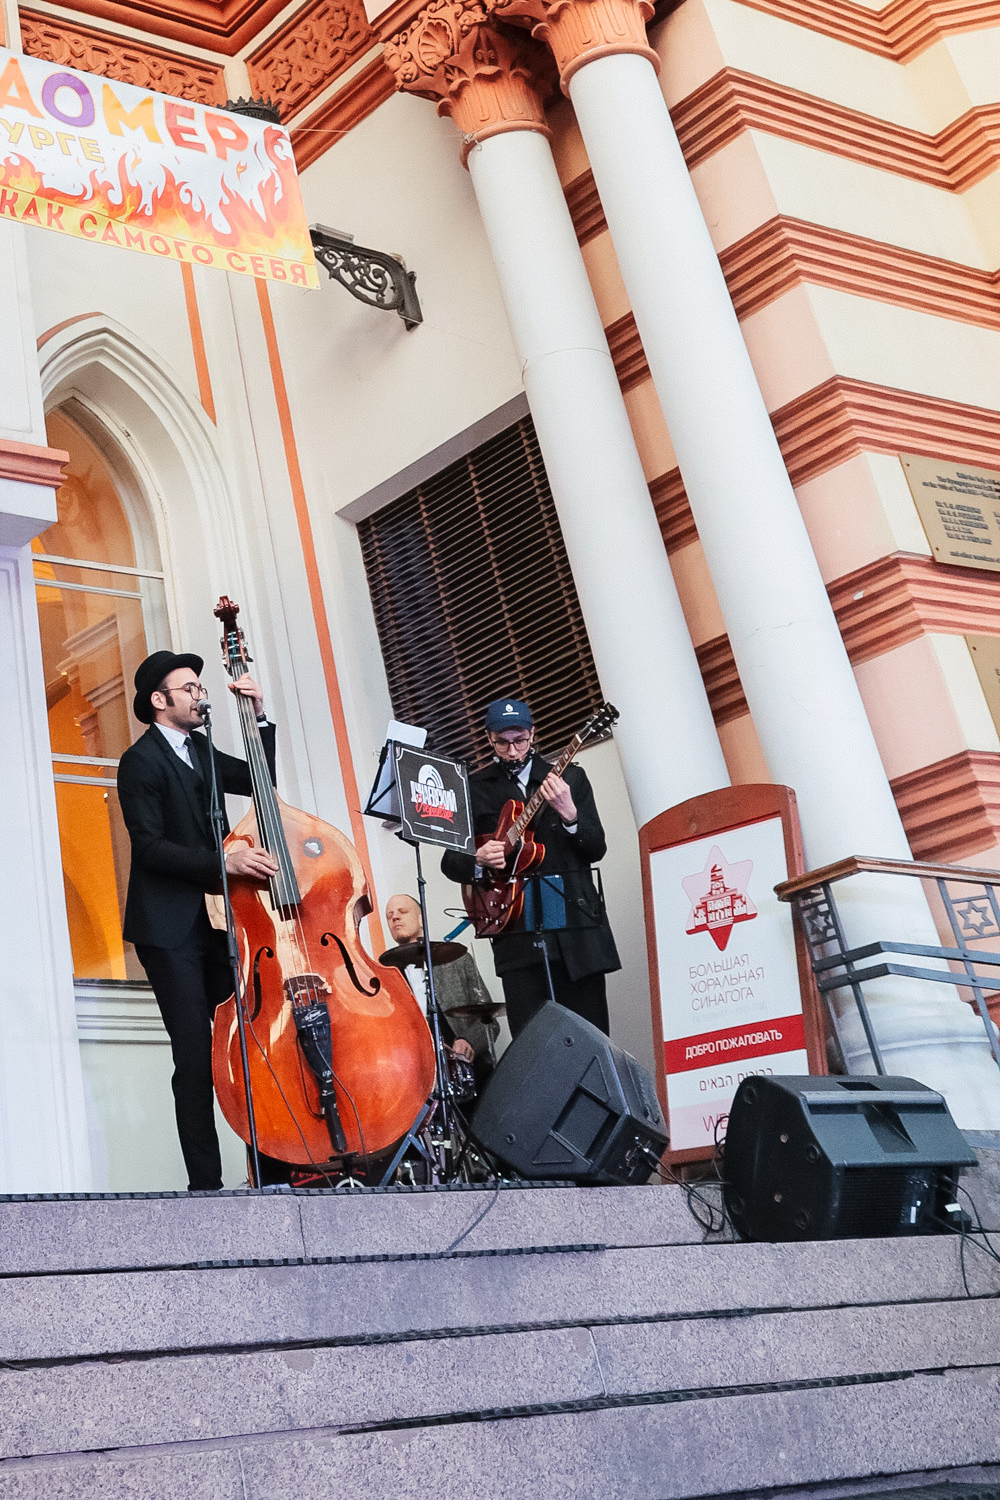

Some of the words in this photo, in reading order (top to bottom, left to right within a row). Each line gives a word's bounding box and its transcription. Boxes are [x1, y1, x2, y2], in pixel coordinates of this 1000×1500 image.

[0, 188, 66, 230] КАК
[80, 213, 214, 265] САМОГО
[226, 252, 309, 287] СЕБЯ
[689, 953, 750, 979] БОЛЬШАЯ
[690, 967, 765, 995] ХОРАЛЬНАЯ
[691, 986, 755, 1011] СИНАГОГА
[685, 1041, 716, 1060] ДОБРО
[715, 1029, 783, 1052] ПОЖАЛОВАТЬ
[699, 1075, 734, 1091] הבאים
